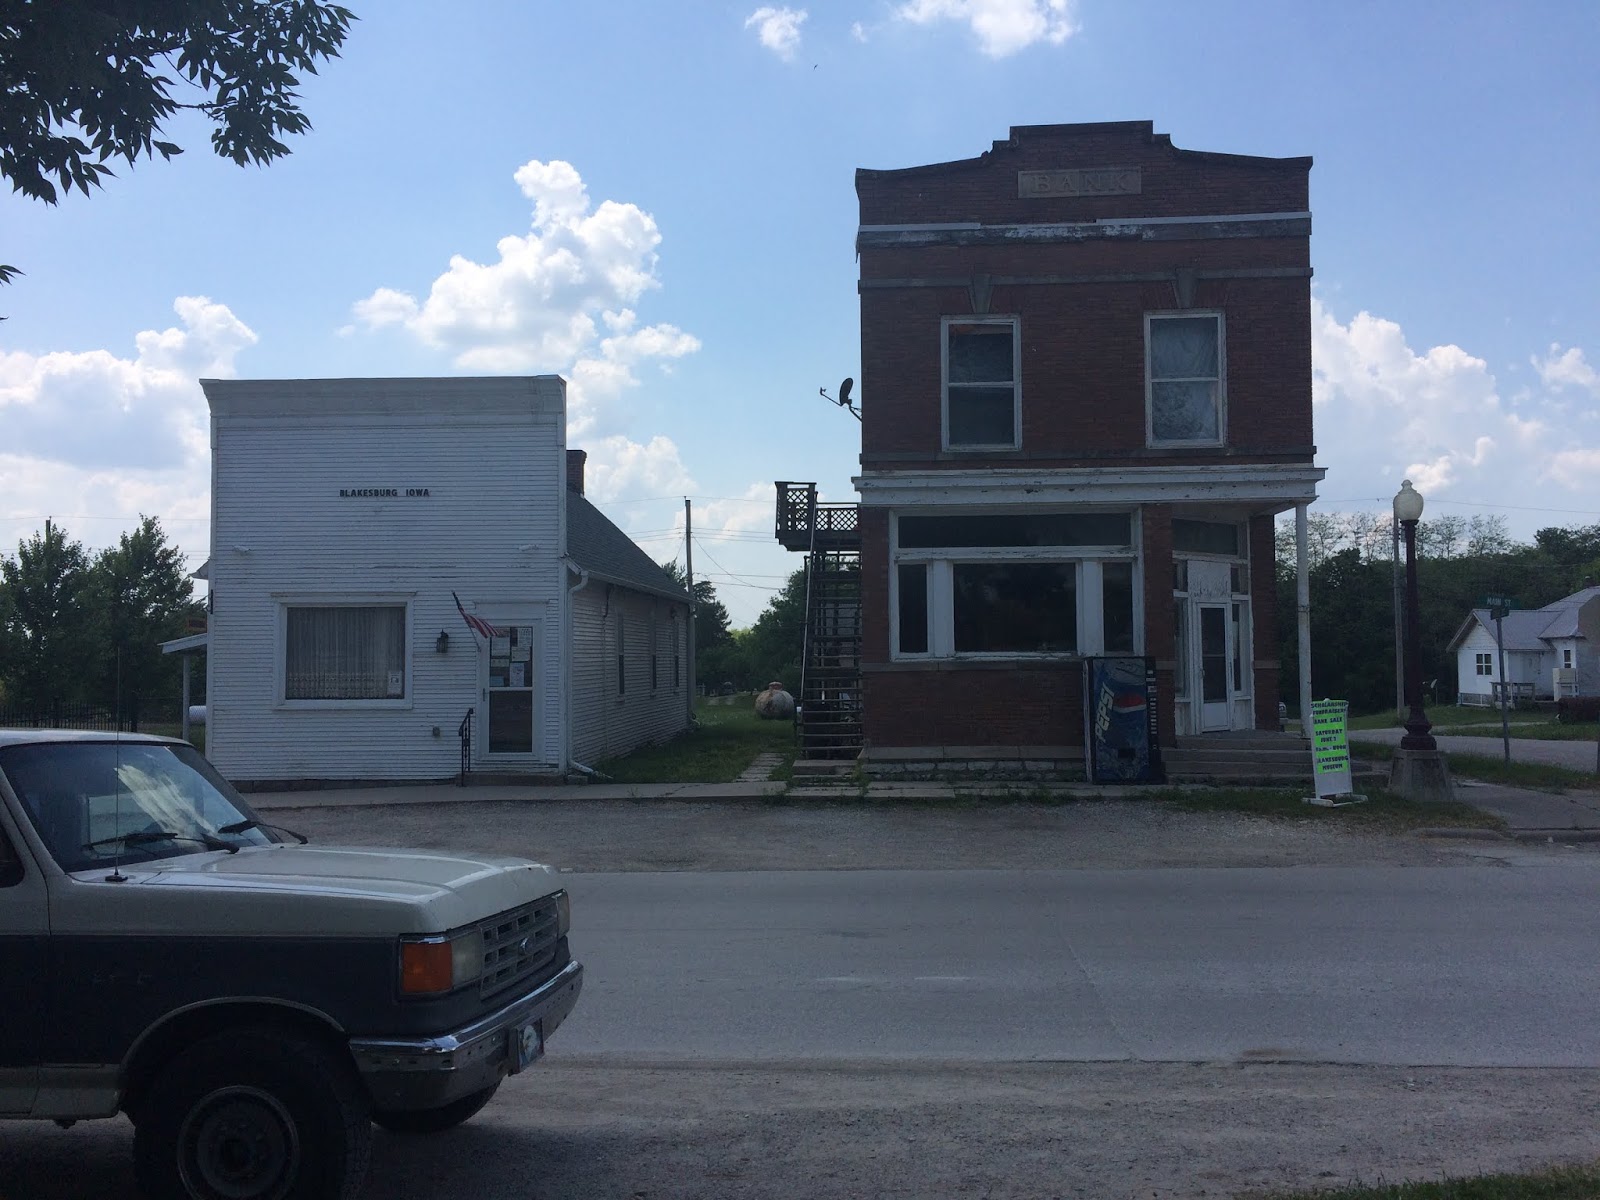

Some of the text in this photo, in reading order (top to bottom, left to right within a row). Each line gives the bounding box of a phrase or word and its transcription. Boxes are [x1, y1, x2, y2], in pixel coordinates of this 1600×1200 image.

[1031, 173, 1133, 193] BANK
[339, 488, 430, 497] BLAKESBURG IOWA
[1094, 681, 1115, 744] PEPSI
